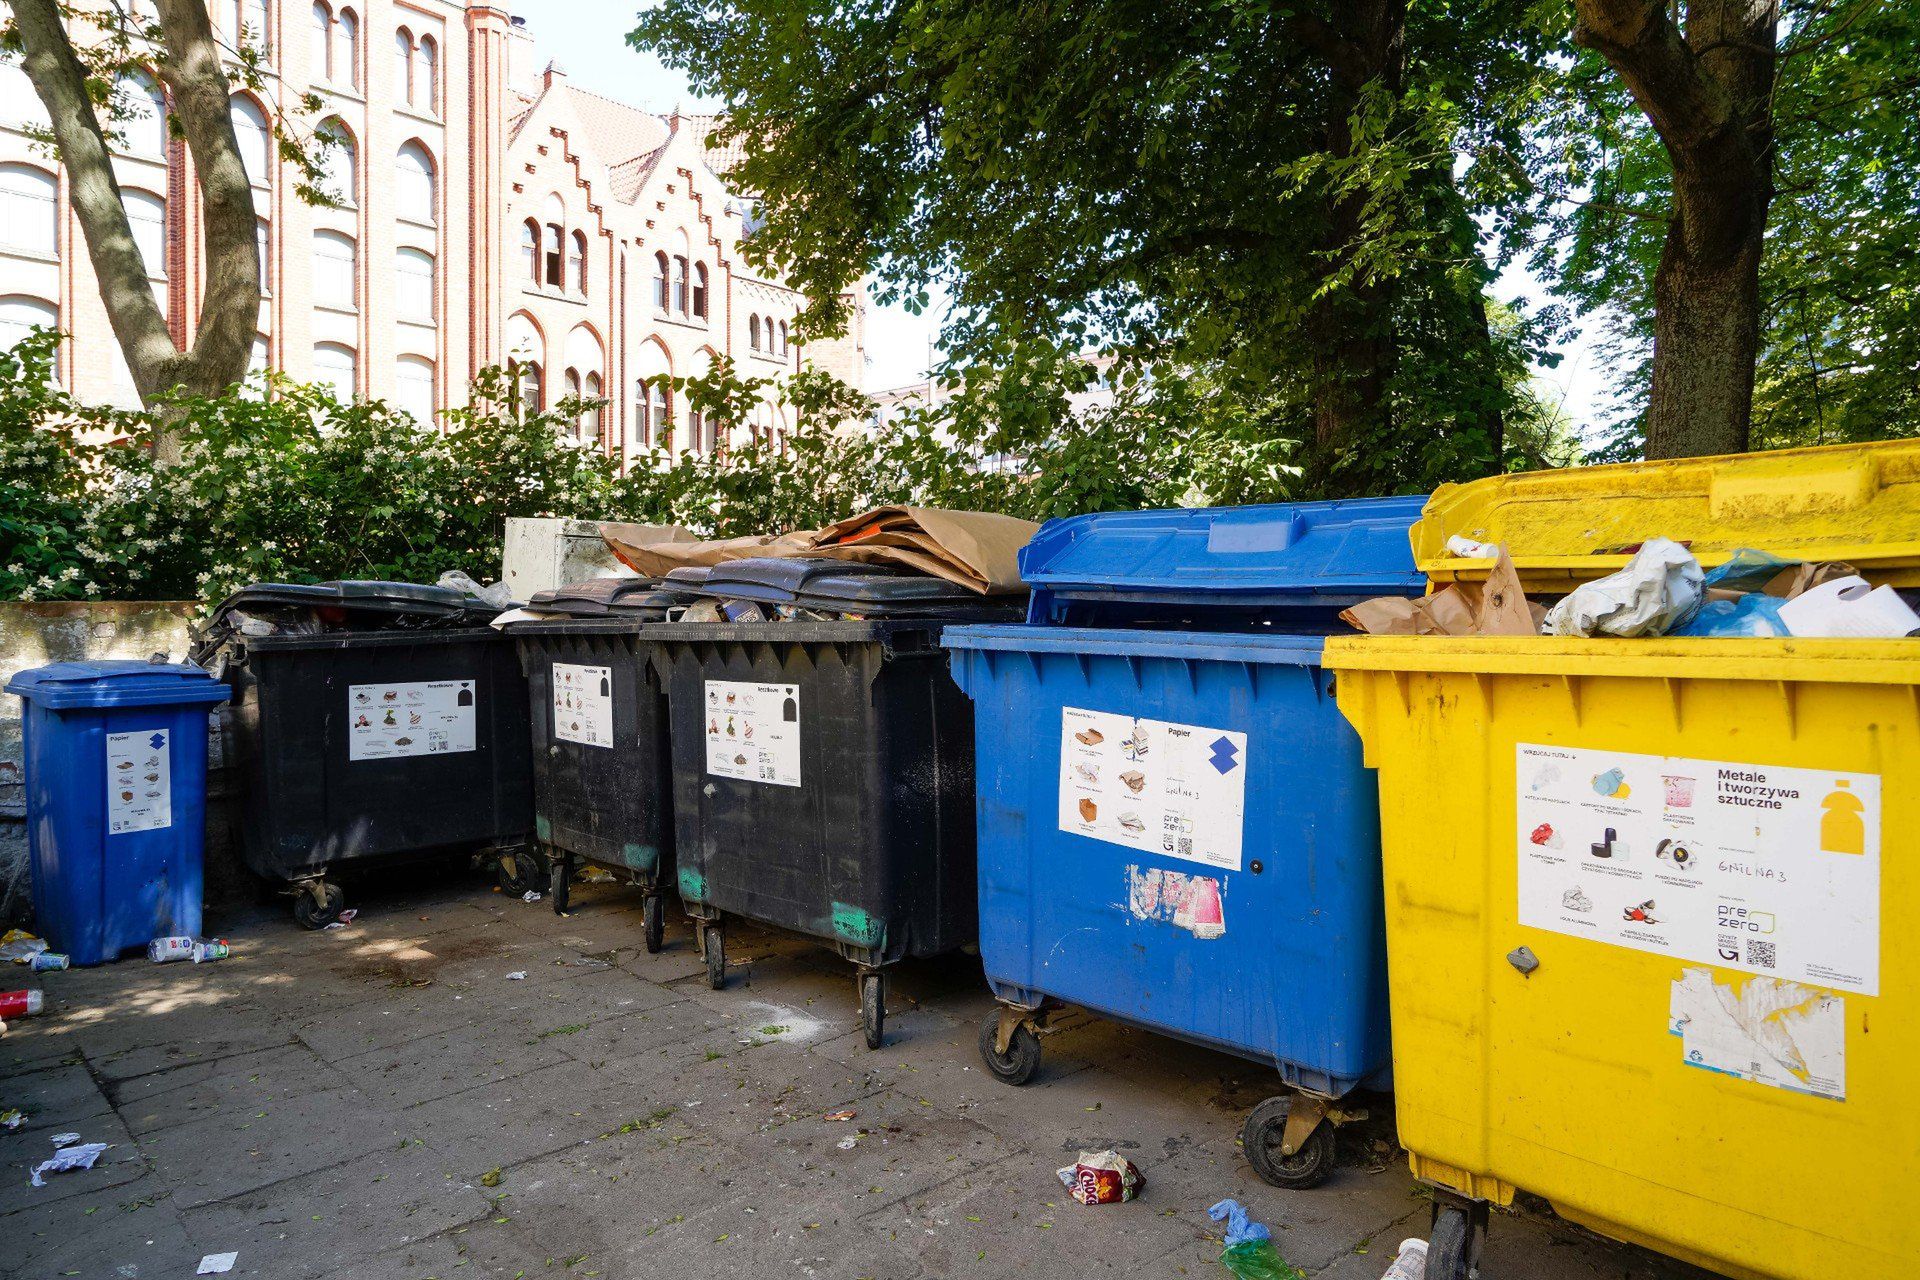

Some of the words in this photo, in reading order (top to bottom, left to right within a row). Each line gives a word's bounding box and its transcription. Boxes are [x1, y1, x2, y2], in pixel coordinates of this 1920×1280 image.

[1168, 727, 1191, 738] Papier
[1718, 769, 1766, 783] Metale
[1718, 781, 1721, 791] i
[1725, 782, 1799, 799] tworzywa
[1717, 794, 1782, 810] sztuczne
[1163, 814, 1179, 824] pre
[1163, 822, 1185, 833] zero
[1778, 871, 1787, 882] 3
[1718, 905, 1747, 918] pre
[1718, 917, 1759, 932] zero
